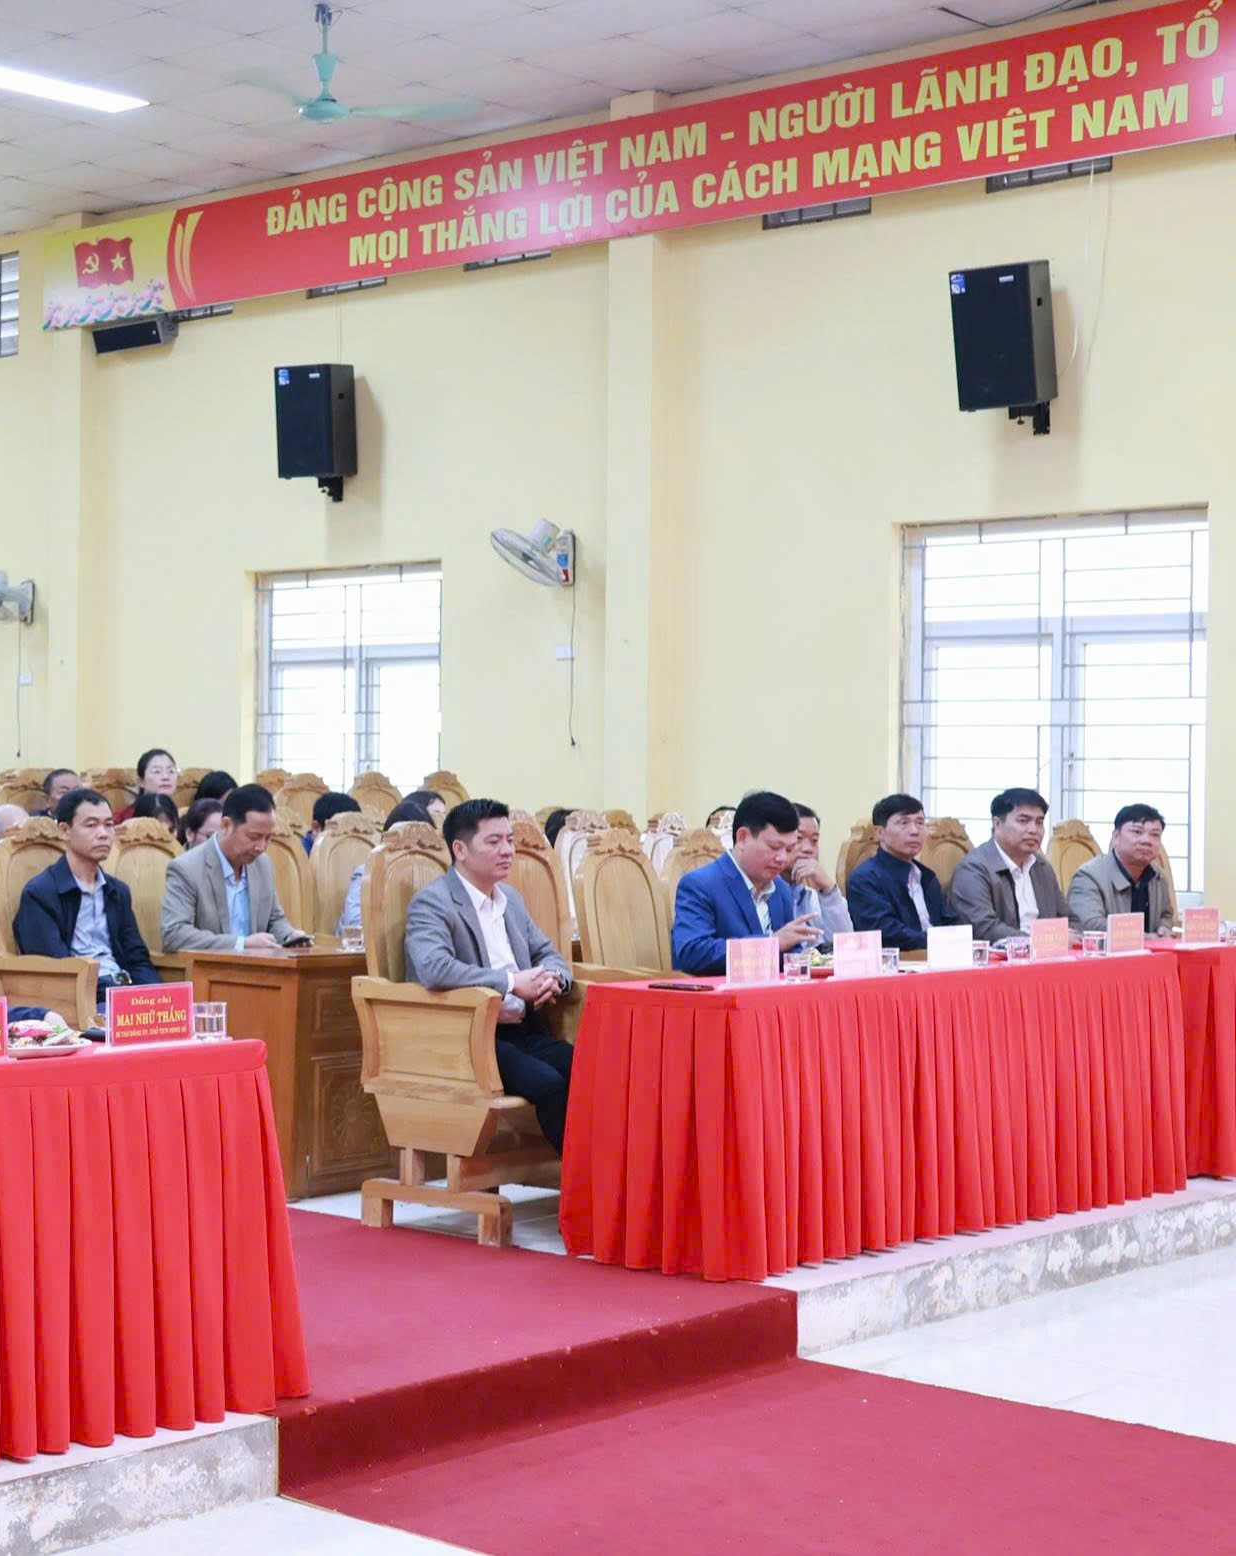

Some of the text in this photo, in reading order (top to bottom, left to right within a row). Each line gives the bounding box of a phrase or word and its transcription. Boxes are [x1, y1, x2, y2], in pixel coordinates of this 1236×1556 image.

[266, 188, 348, 236] ĐẢNG
[357, 174, 444, 221] CỘNG
[453, 151, 523, 201] SẢN
[533, 139, 608, 187] VIỆT
[619, 122, 707, 171] NAM
[748, 82, 875, 146] NGƯỜI
[891, 60, 1008, 119] LÃNH
[1023, 37, 1138, 93] ĐẠO,
[1155, 0, 1224, 65] TỔ
[349, 76, 1225, 268] MỌI THẮNG LỢI CỦA CÁCH MẠNG VIỆT NAM !
[116, 1013, 134, 1026] MAI
[156, 1004, 187, 1023] THẮNG
